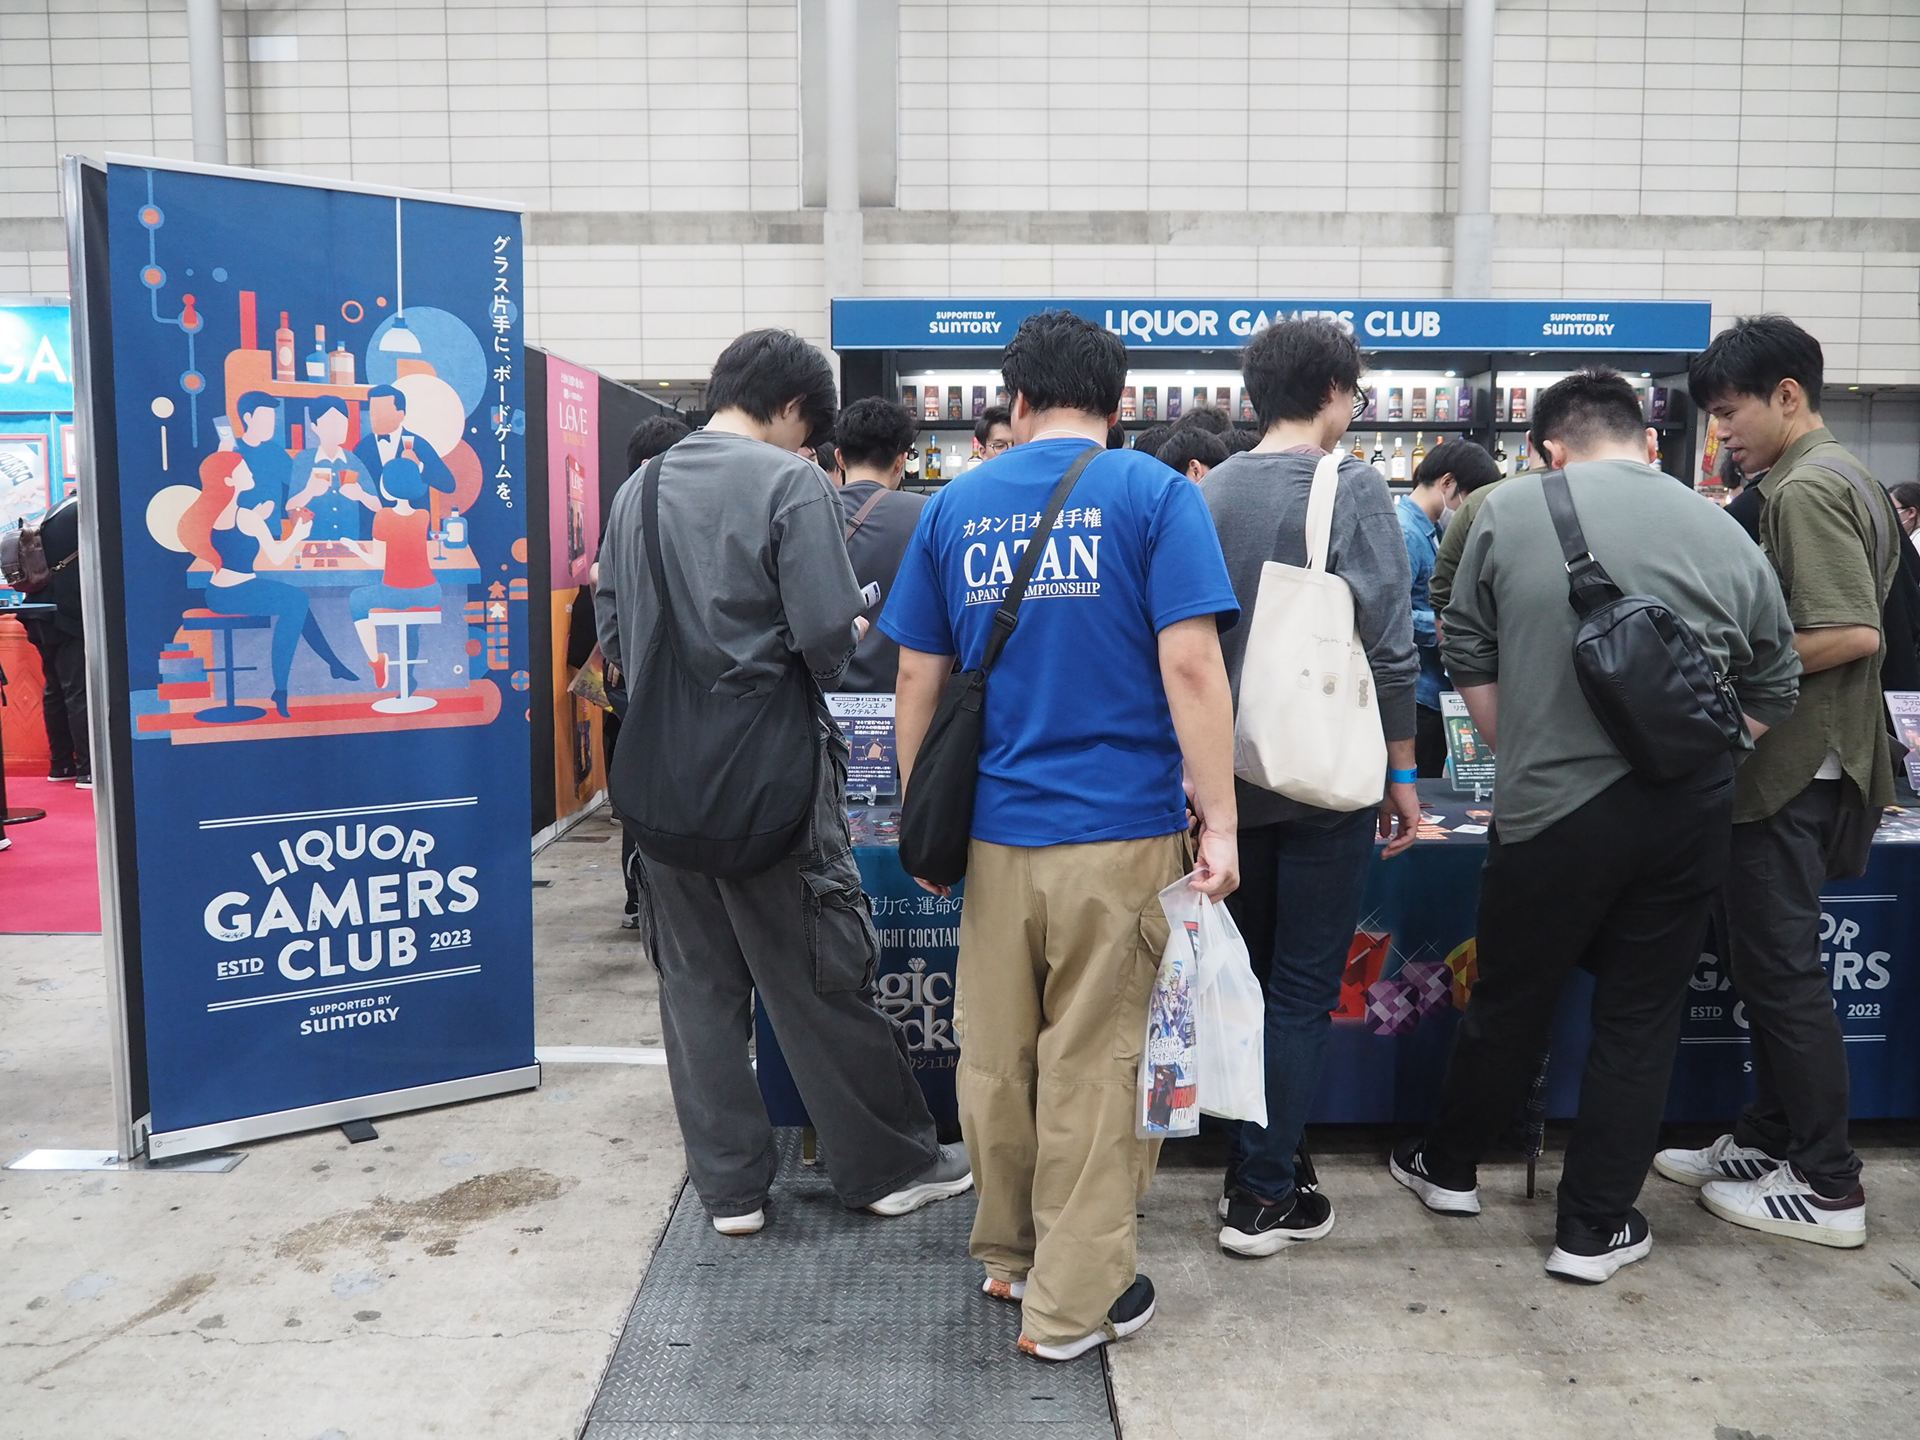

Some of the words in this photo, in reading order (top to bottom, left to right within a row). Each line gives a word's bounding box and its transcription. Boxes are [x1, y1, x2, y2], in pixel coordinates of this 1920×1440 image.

[936, 311, 981, 320] SUPPORTED
[982, 311, 996, 320] BY
[1105, 309, 1218, 342] LIQUOR
[1364, 310, 1441, 338] CLUB
[1549, 313, 1597, 322] SUPPORTED
[1598, 313, 1610, 322] BY
[493, 235, 513, 509] グラス片手に、ボードゲームを。
[559, 401, 588, 435] LOVE
[965, 587, 999, 603] JAPAN
[1002, 582, 1101, 598] CMPIONSHIP
[251, 824, 435, 885] LIQUOR
[204, 866, 479, 942] GAMERS
[217, 957, 264, 978] ESTD
[278, 927, 417, 981] CLUB
[430, 929, 472, 949] 2023
[309, 998, 375, 1016] SUPPORTED
[378, 995, 392, 1006] BY
[876, 970, 953, 1019] gic
[1690, 1006, 1723, 1018] ESTD
[1847, 1004, 1881, 1016] 2023
